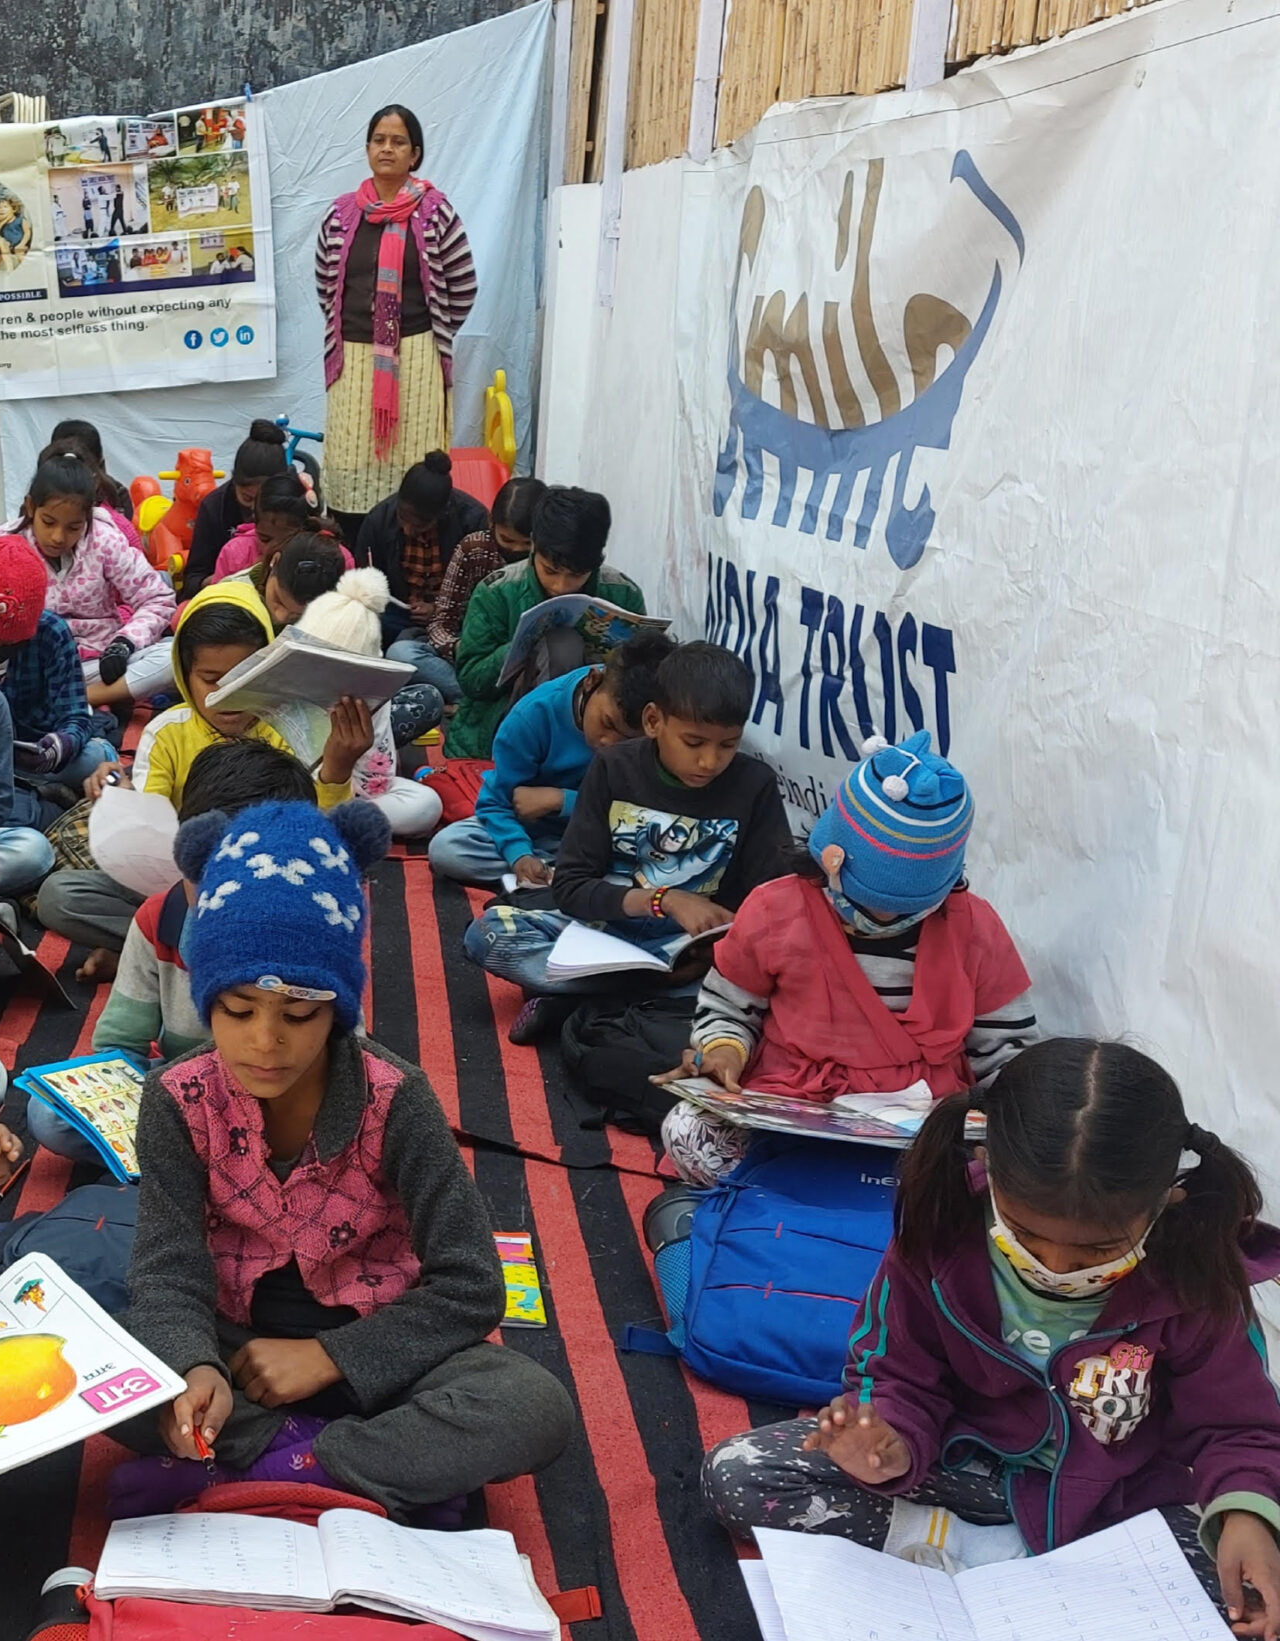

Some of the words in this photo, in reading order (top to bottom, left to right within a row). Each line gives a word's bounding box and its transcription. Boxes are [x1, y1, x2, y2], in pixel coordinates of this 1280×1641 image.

[0, 290, 42, 301] POSSIBLE
[26, 312, 36, 323] &
[40, 308, 84, 325] people
[87, 304, 137, 318] without
[140, 299, 206, 315] expecting
[208, 297, 232, 310] any
[20, 327, 54, 339] most
[57, 321, 108, 336] selfless
[111, 319, 149, 333] thing.
[799, 585, 957, 762] TRUST
[93, 1376, 153, 1409] आ
